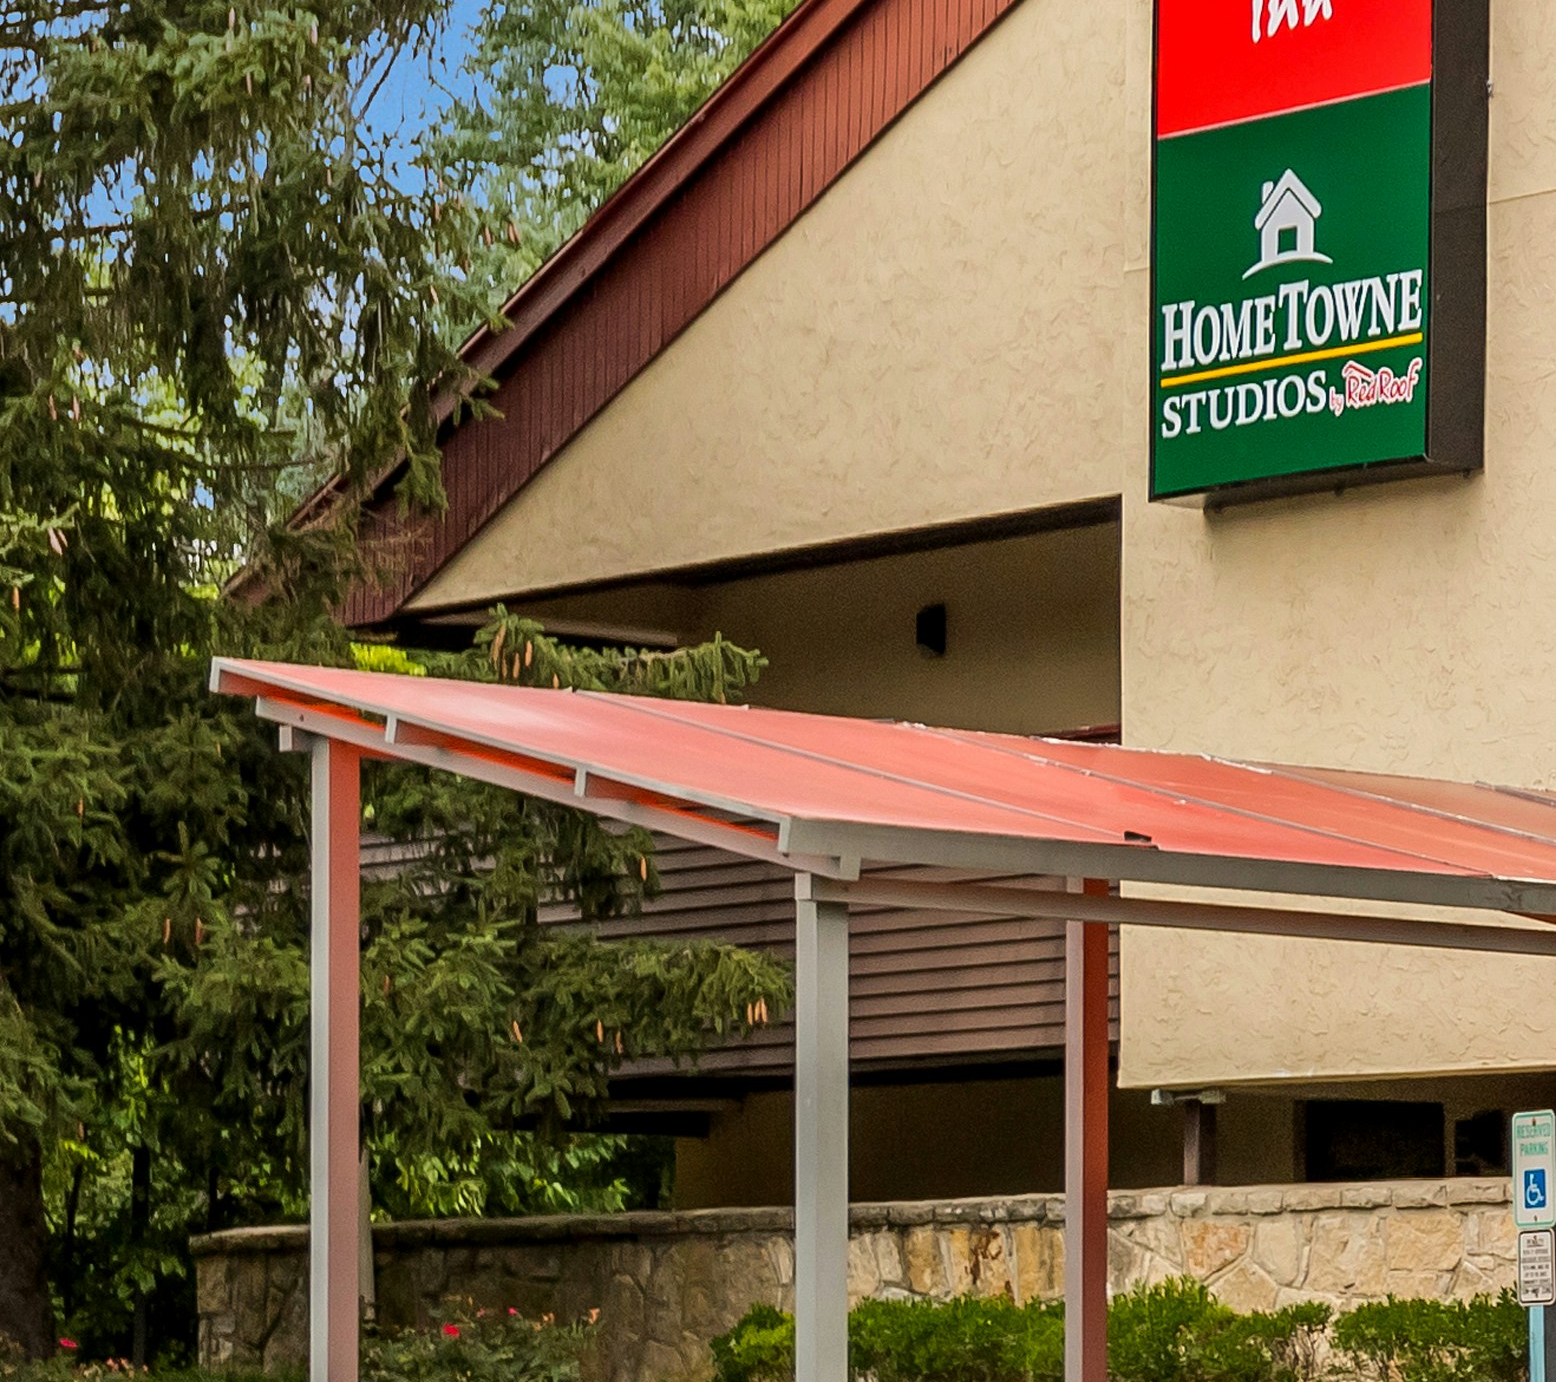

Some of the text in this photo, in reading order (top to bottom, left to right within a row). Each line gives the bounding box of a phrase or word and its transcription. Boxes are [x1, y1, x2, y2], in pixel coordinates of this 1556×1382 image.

[1161, 357, 1423, 439] STUDIOS by Red Roof
[1516, 1123, 1552, 1139] RESERVED
[1520, 1142, 1549, 1156] PARKING
